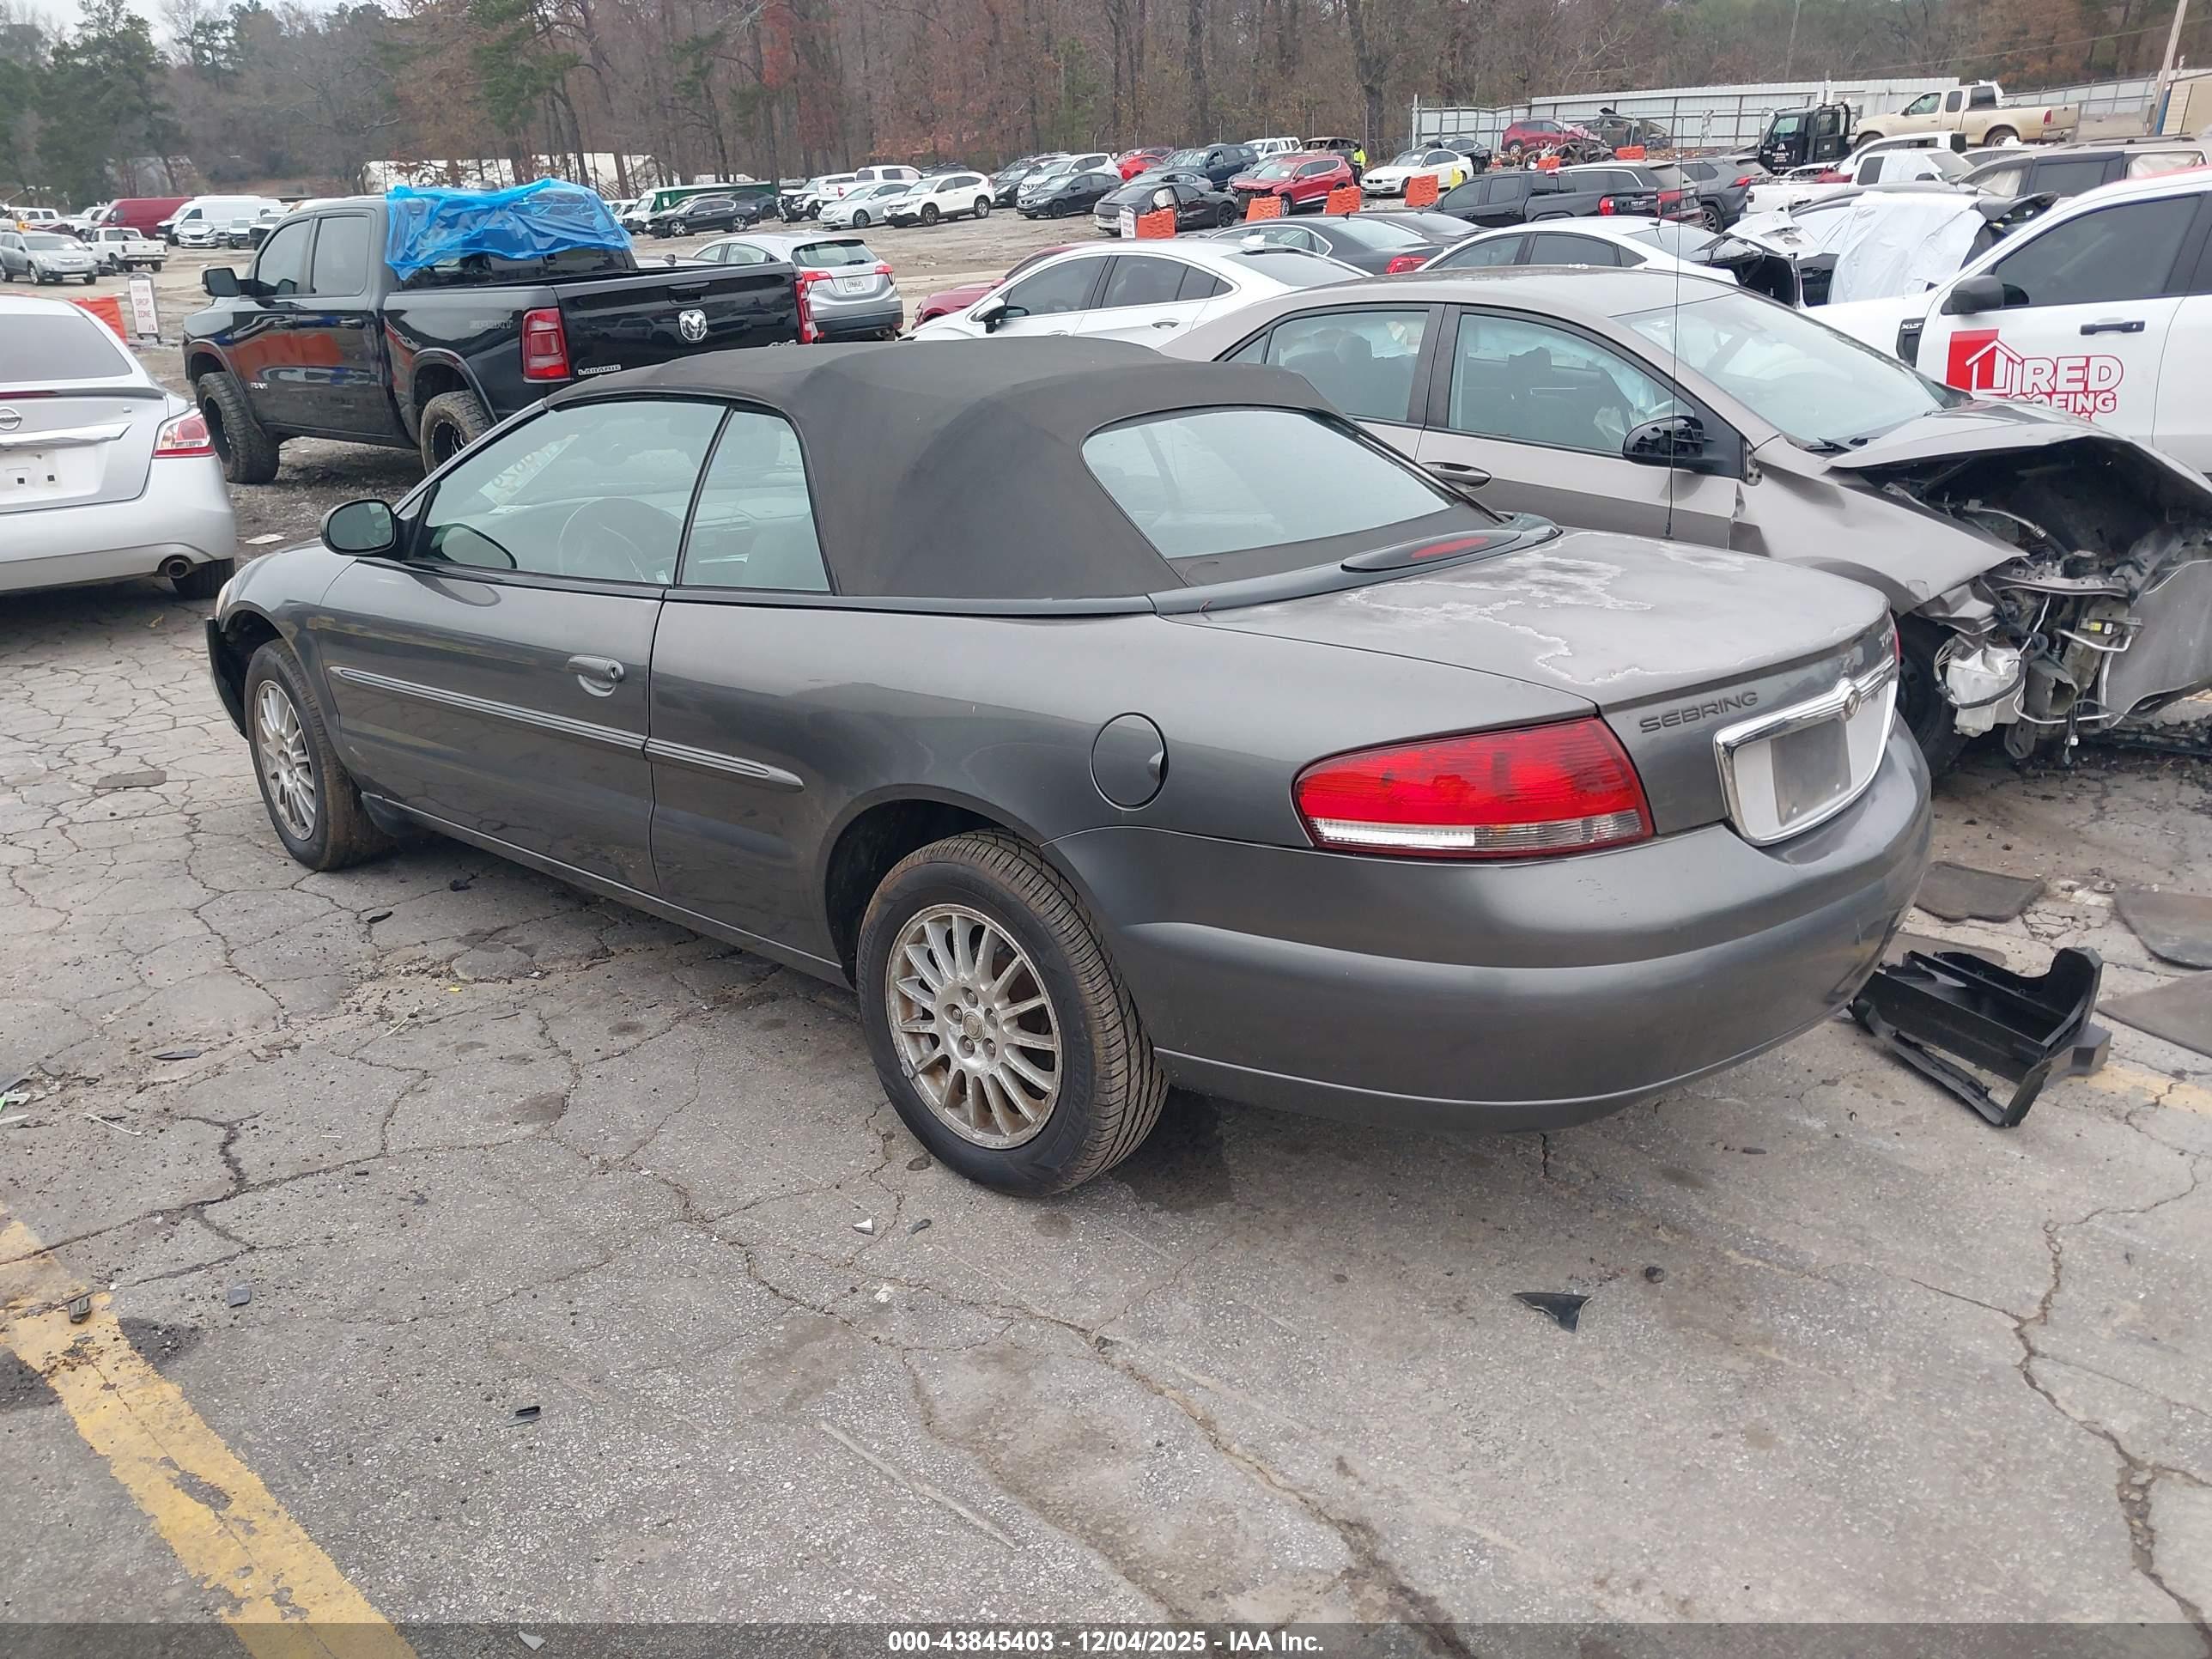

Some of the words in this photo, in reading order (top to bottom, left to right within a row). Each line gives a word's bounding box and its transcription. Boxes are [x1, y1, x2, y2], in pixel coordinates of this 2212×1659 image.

[577, 364, 622, 376] LARAMIE
[2021, 355, 2124, 394] RED
[1639, 691, 1759, 733] SEBRING
